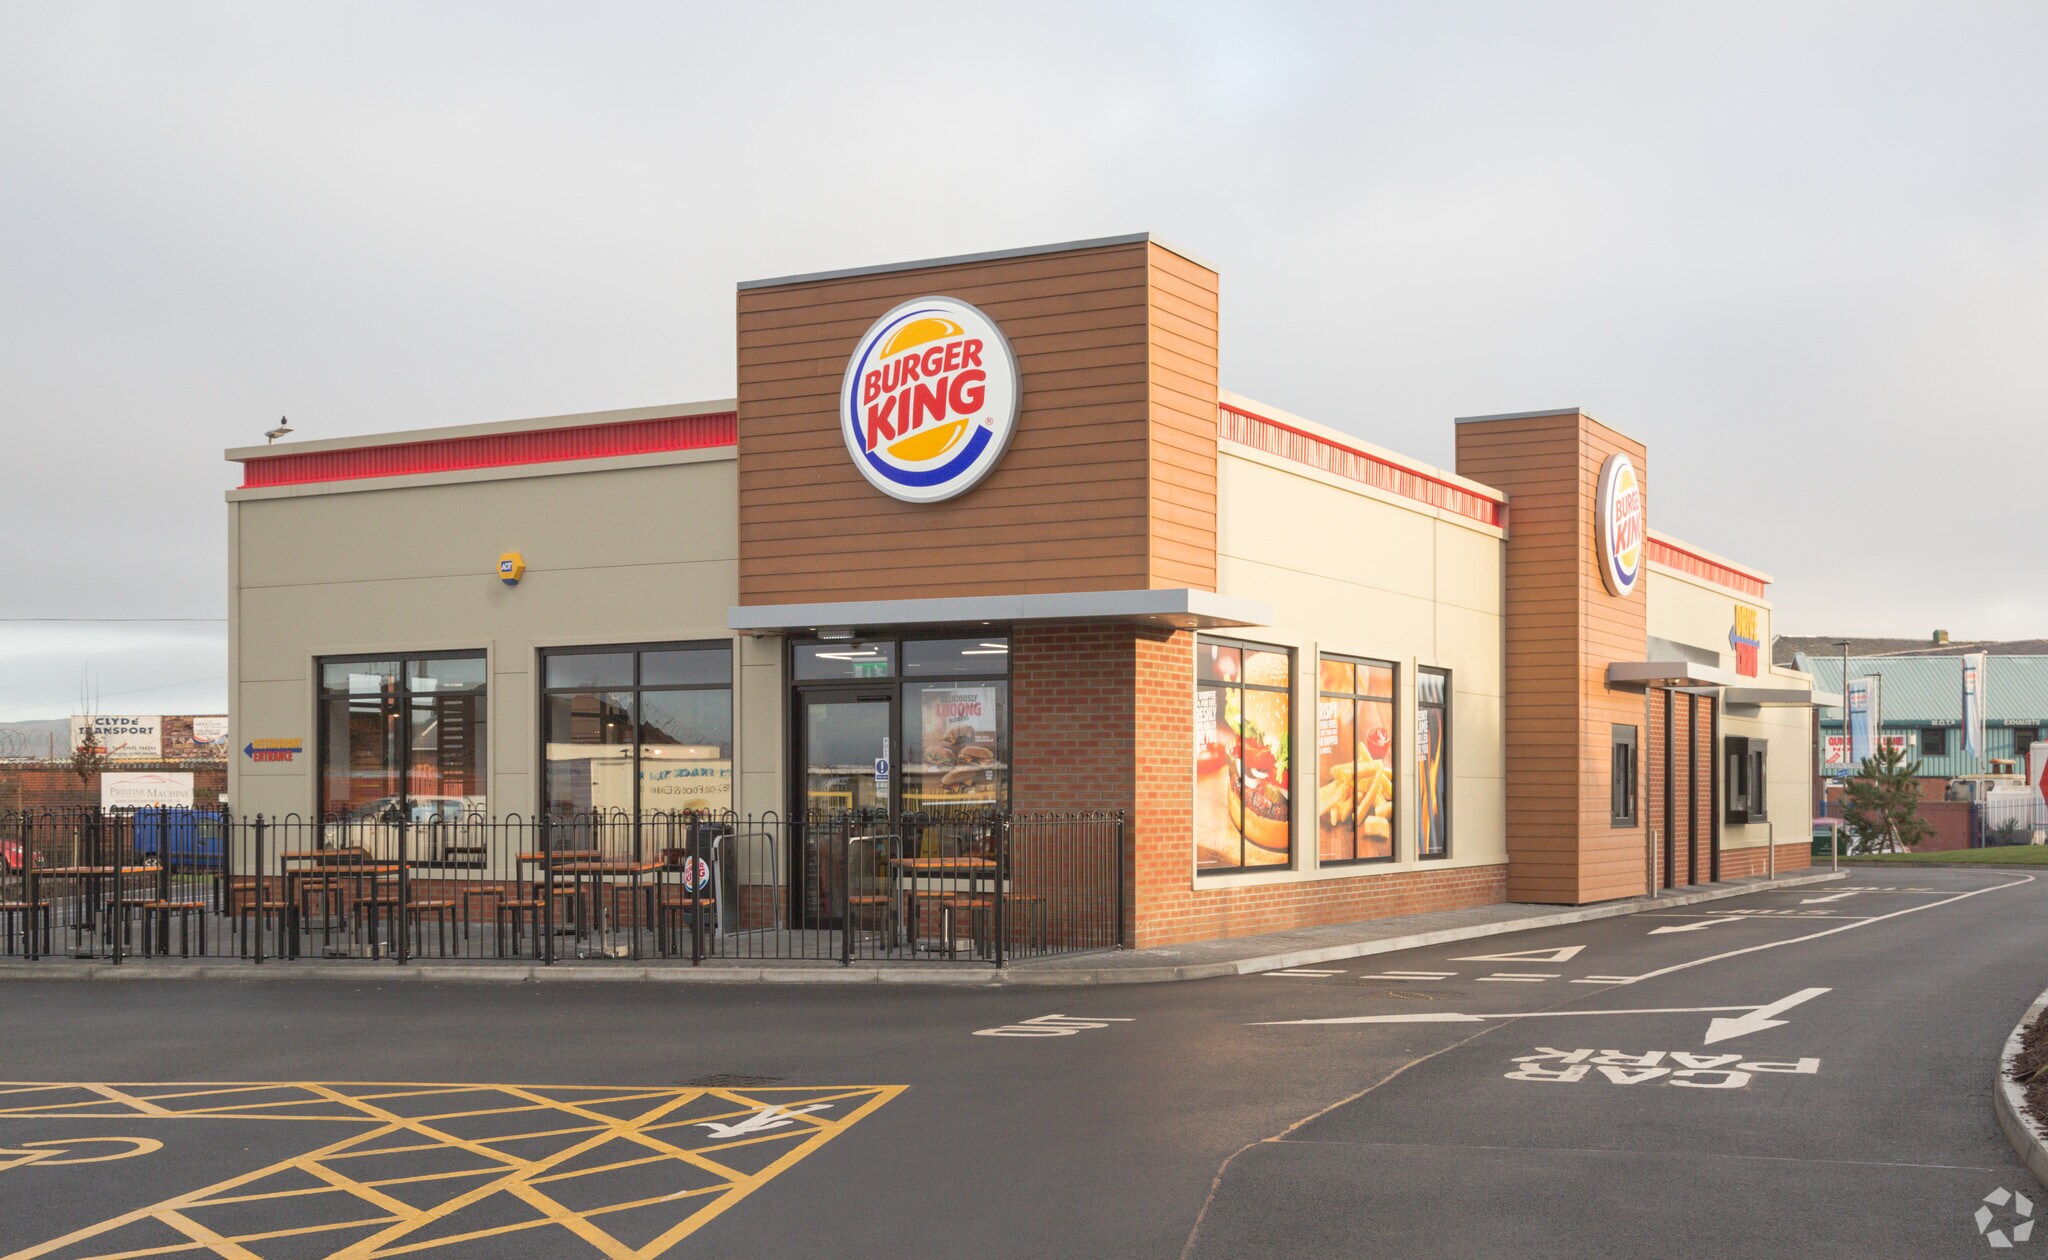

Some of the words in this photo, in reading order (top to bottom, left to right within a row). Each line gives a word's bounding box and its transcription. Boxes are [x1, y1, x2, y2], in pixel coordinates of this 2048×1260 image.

[864, 339, 984, 406] BURGER
[867, 369, 987, 452] KING
[1735, 605, 1758, 640] DRIVE
[253, 738, 303, 749] RESTAURANT
[253, 751, 293, 762] ENTRANCE
[110, 787, 145, 798] PRISTINE
[147, 788, 190, 799] MACHINE
[971, 1014, 1137, 1037] OUT
[1511, 1047, 1821, 1074] PARK
[1503, 1062, 1752, 1089] CAR
